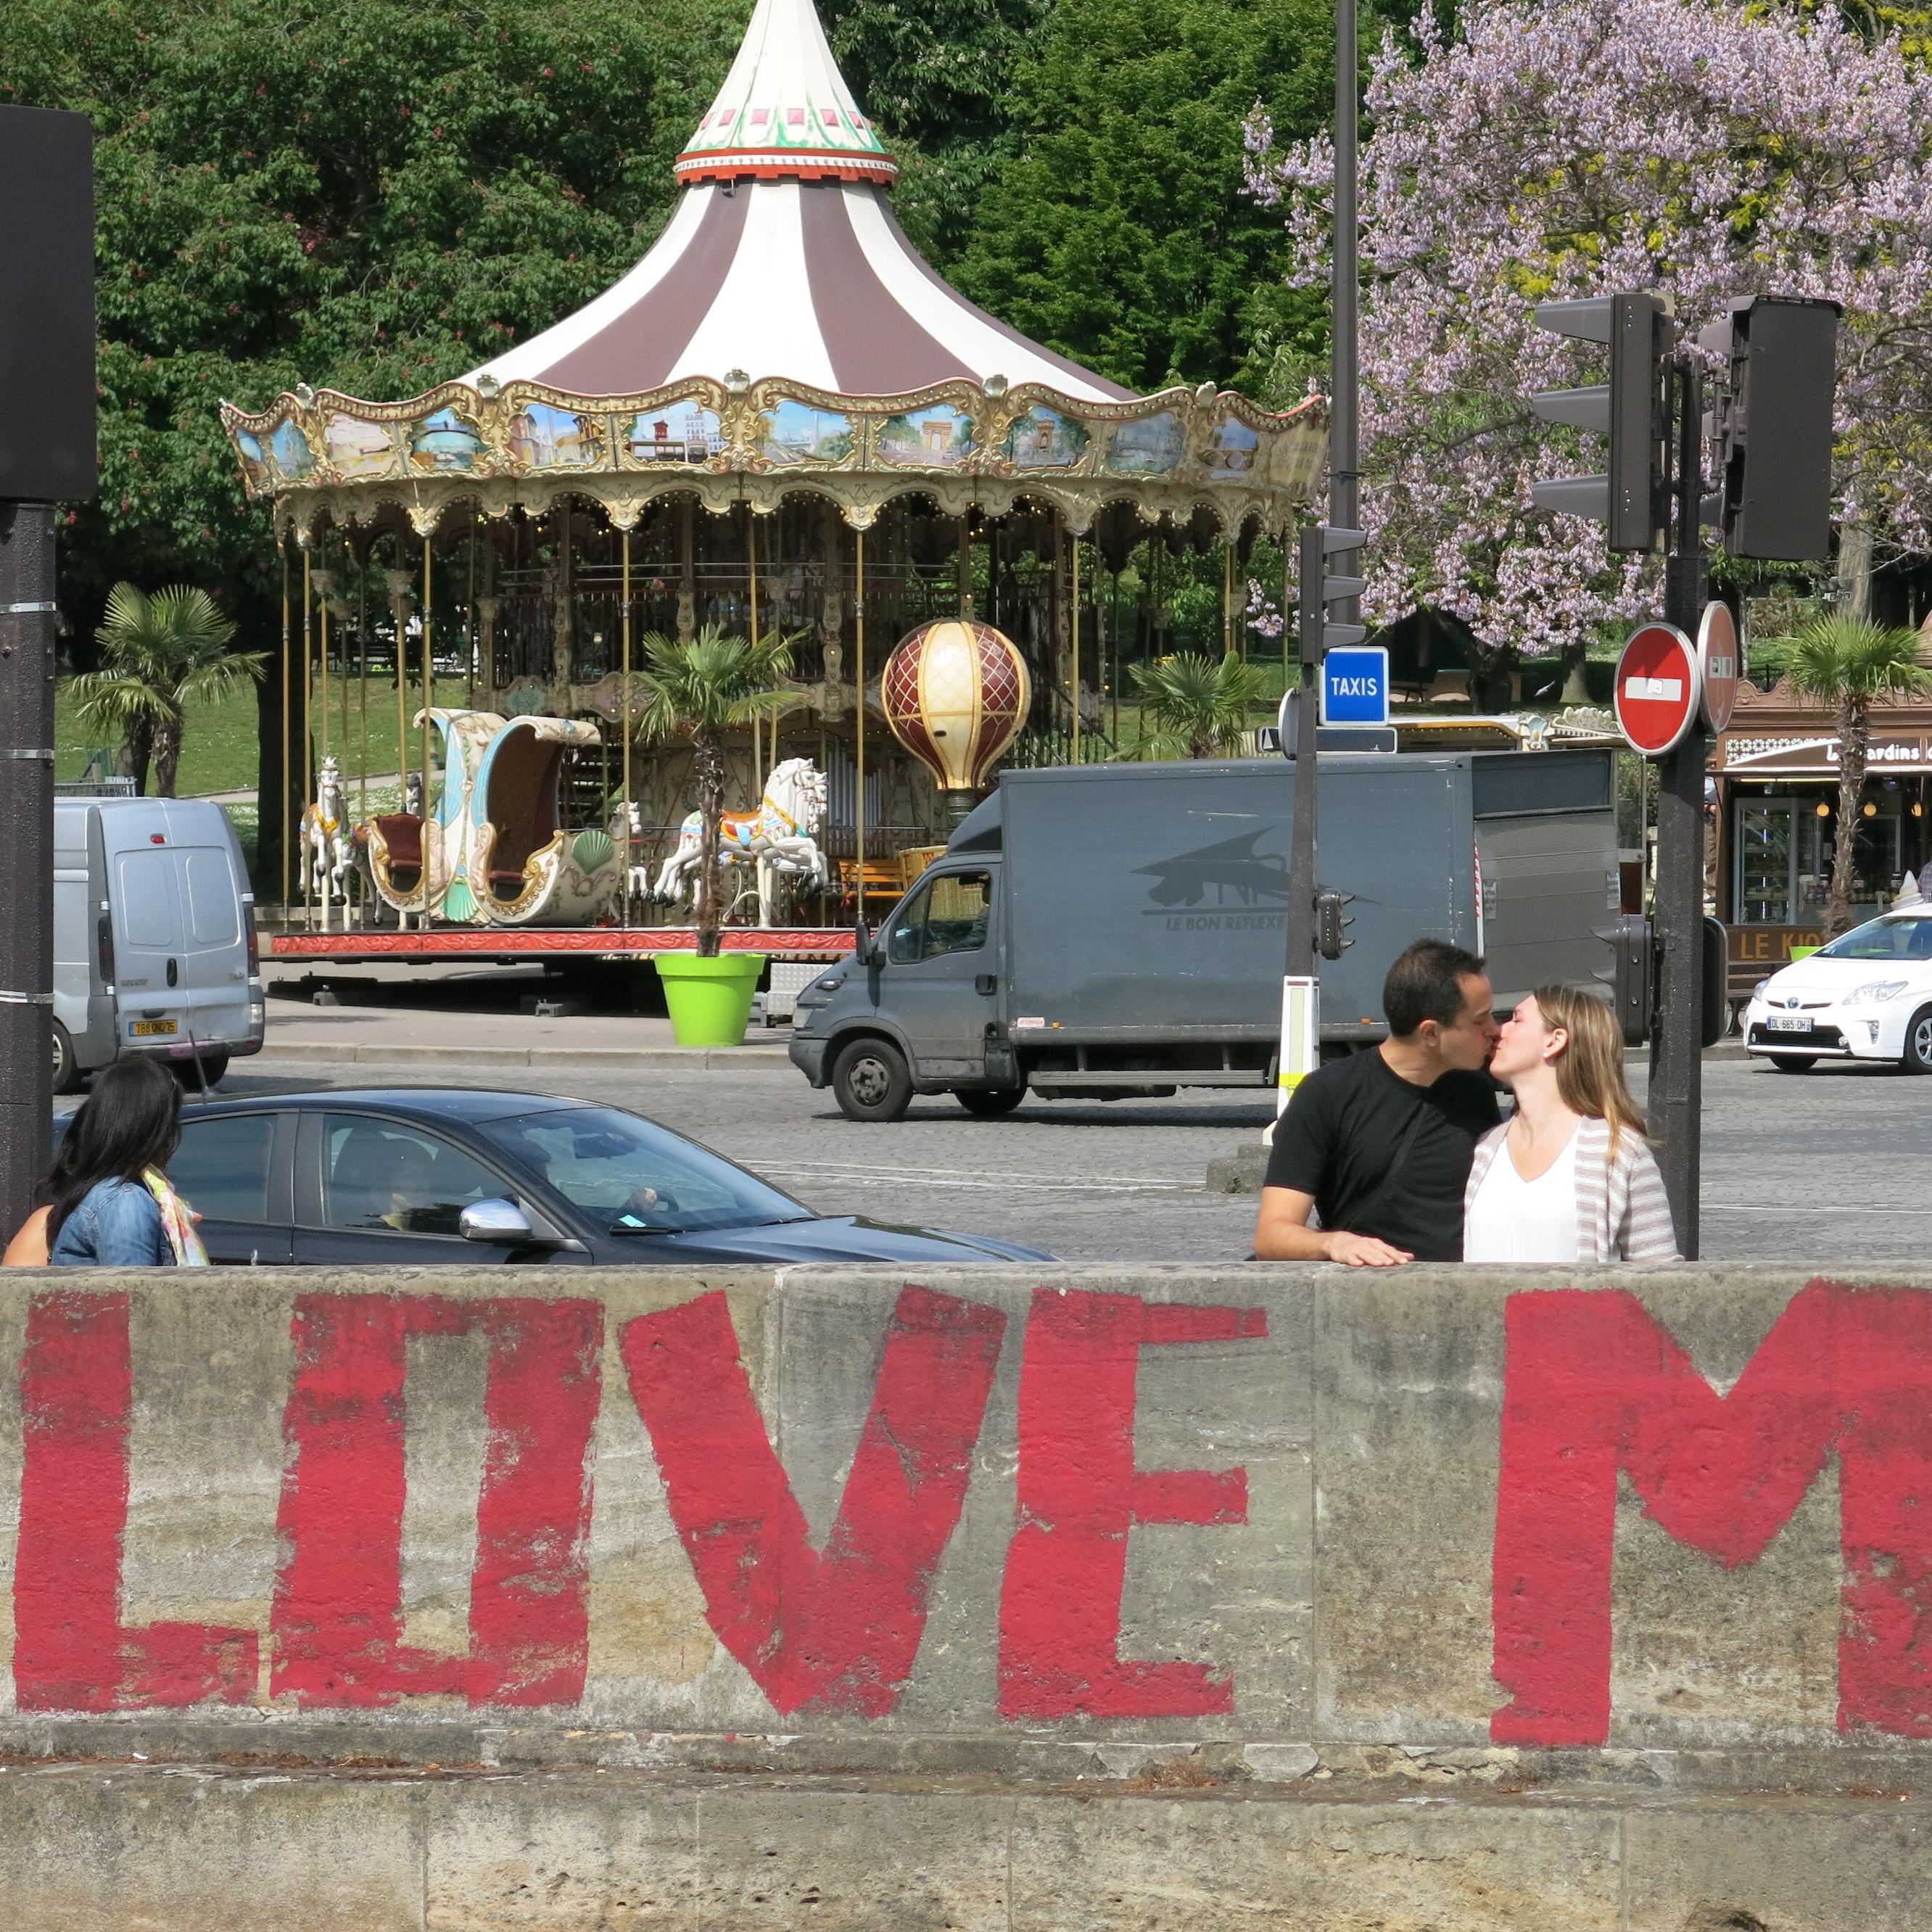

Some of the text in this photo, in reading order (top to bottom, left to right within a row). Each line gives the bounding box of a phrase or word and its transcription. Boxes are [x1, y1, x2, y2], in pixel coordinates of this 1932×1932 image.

[1330, 677, 1377, 696] TAXIS
[1859, 743, 1920, 761] ardins
[1165, 917, 1181, 931] LE
[1186, 916, 1220, 930] BON
[1741, 933, 1769, 959] LE
[13, 1284, 1268, 1721] LOVE
